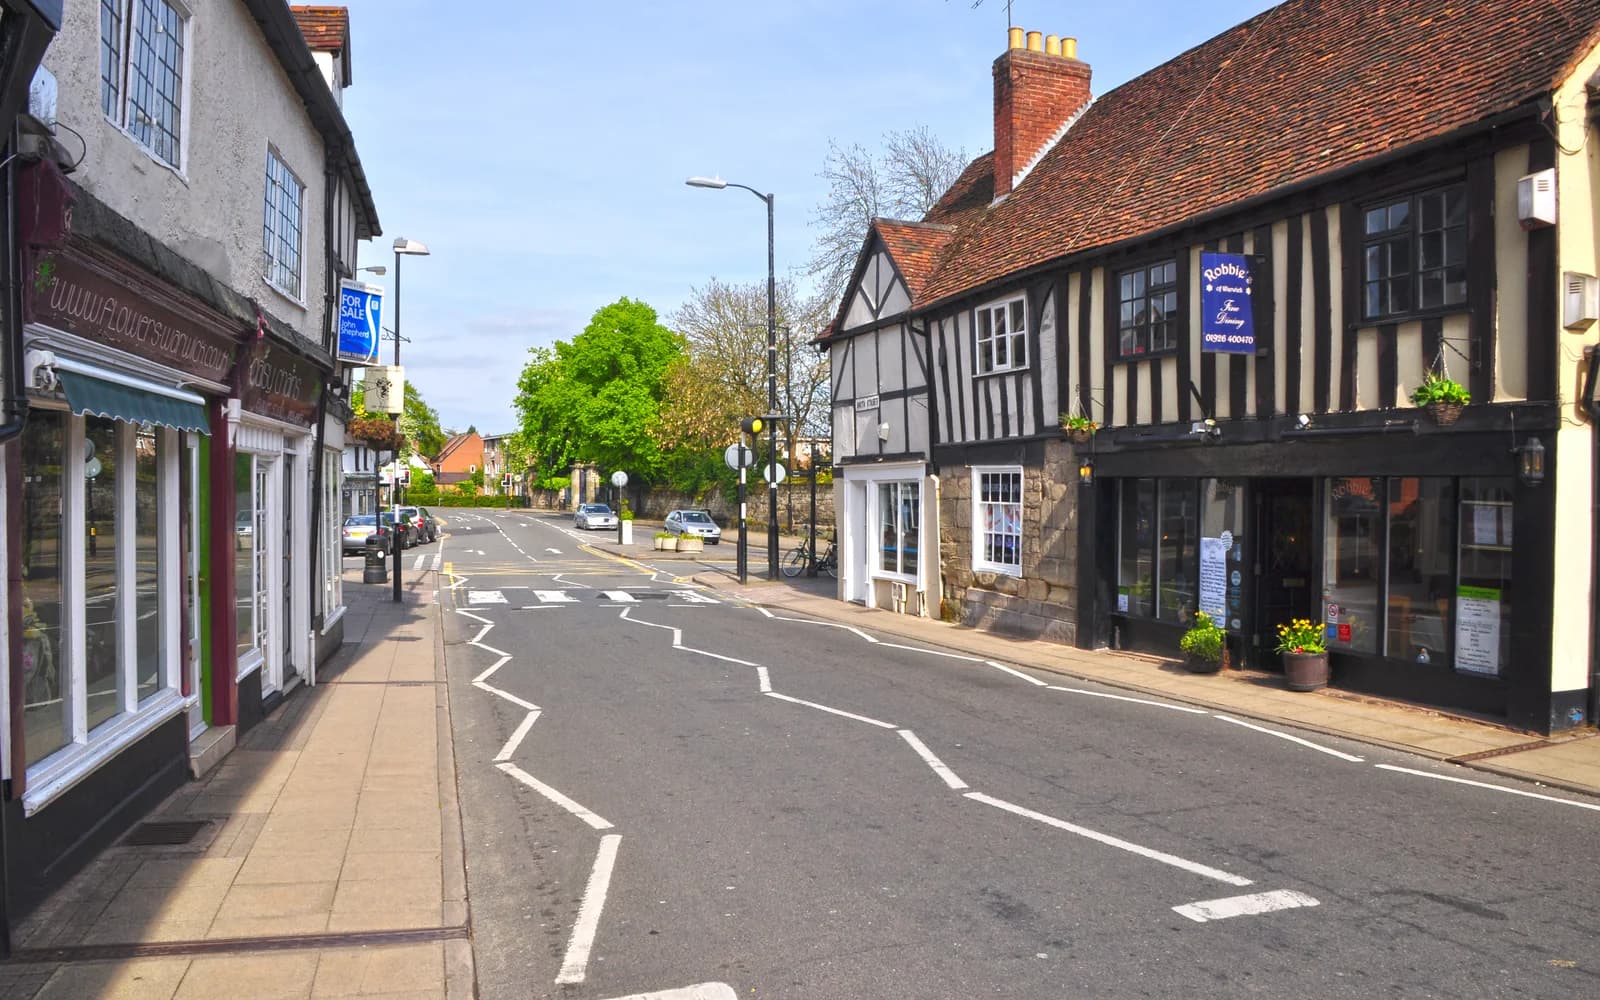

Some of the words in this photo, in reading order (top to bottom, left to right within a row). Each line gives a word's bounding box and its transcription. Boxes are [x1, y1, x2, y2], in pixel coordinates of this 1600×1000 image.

[1203, 263, 1253, 284] Robbie's
[341, 294, 361, 308] FOR
[1220, 299, 1240, 312] Fine
[341, 306, 365, 320] SALE
[341, 320, 356, 329] John
[1214, 311, 1245, 330] Dining
[340, 327, 370, 339] Shepherd
[1205, 334, 1227, 343] 01926
